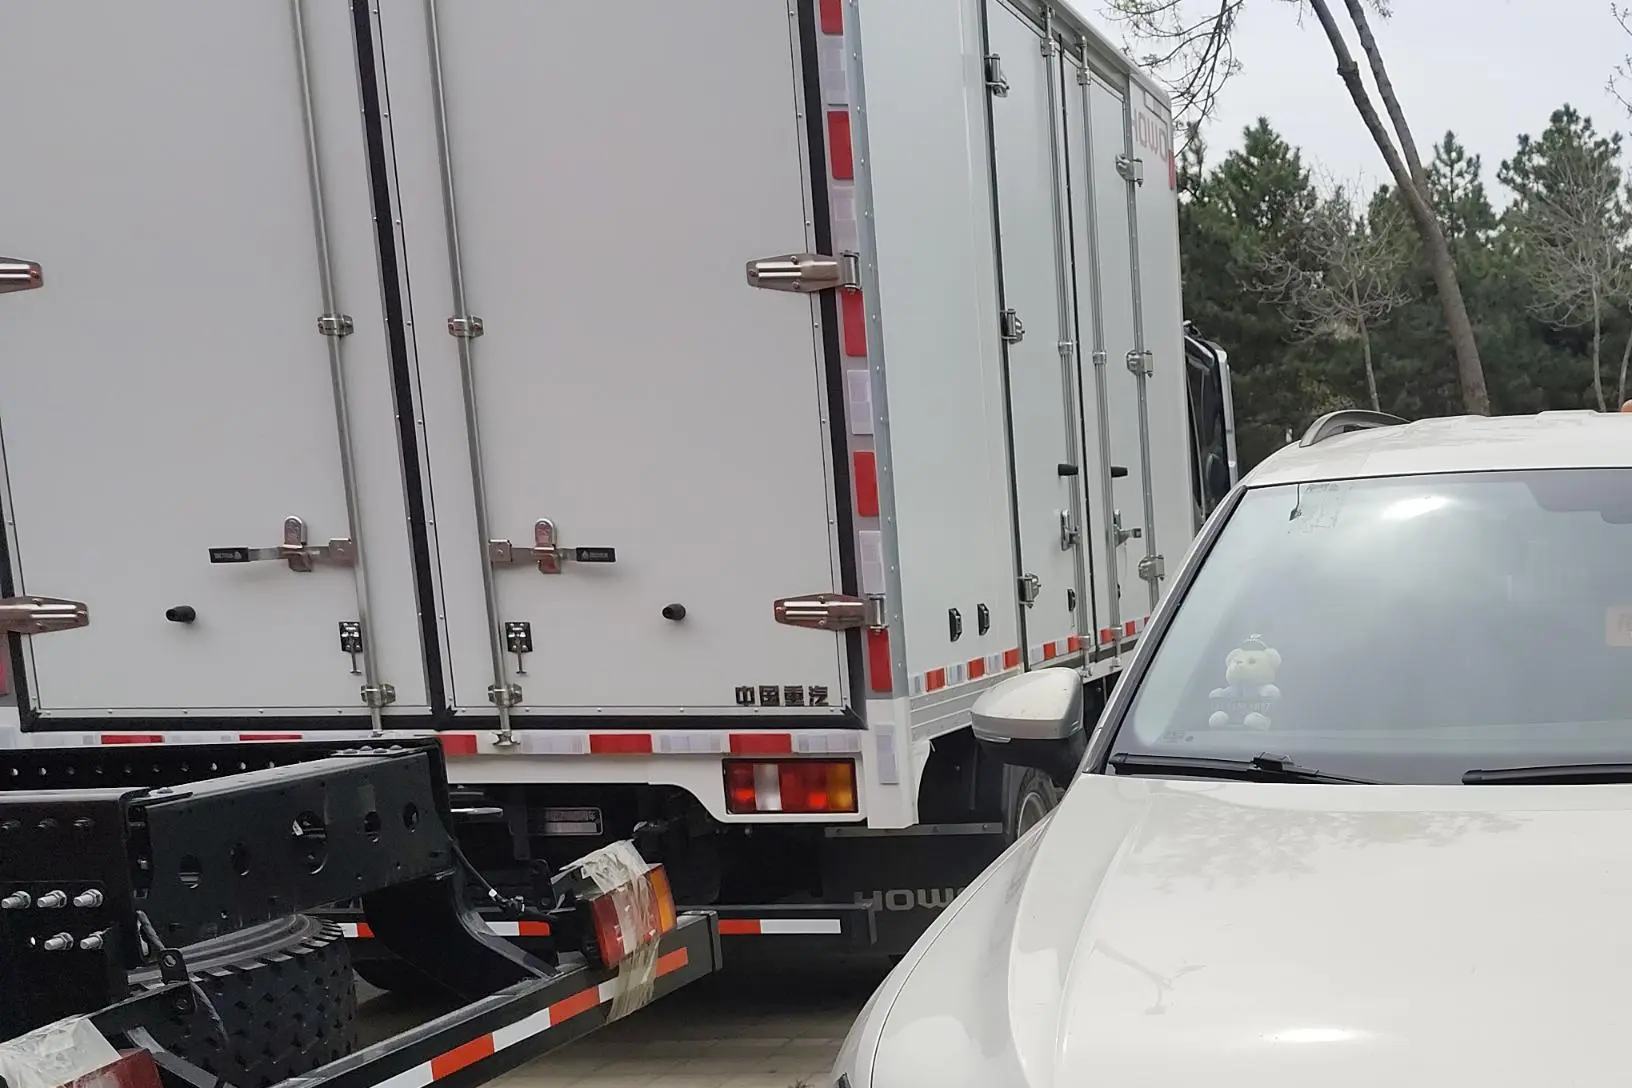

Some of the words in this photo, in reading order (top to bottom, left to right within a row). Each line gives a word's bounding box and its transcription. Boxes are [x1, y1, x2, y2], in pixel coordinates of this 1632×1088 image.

[735, 685, 829, 707] 中国重汽
[854, 887, 965, 911] HOW
